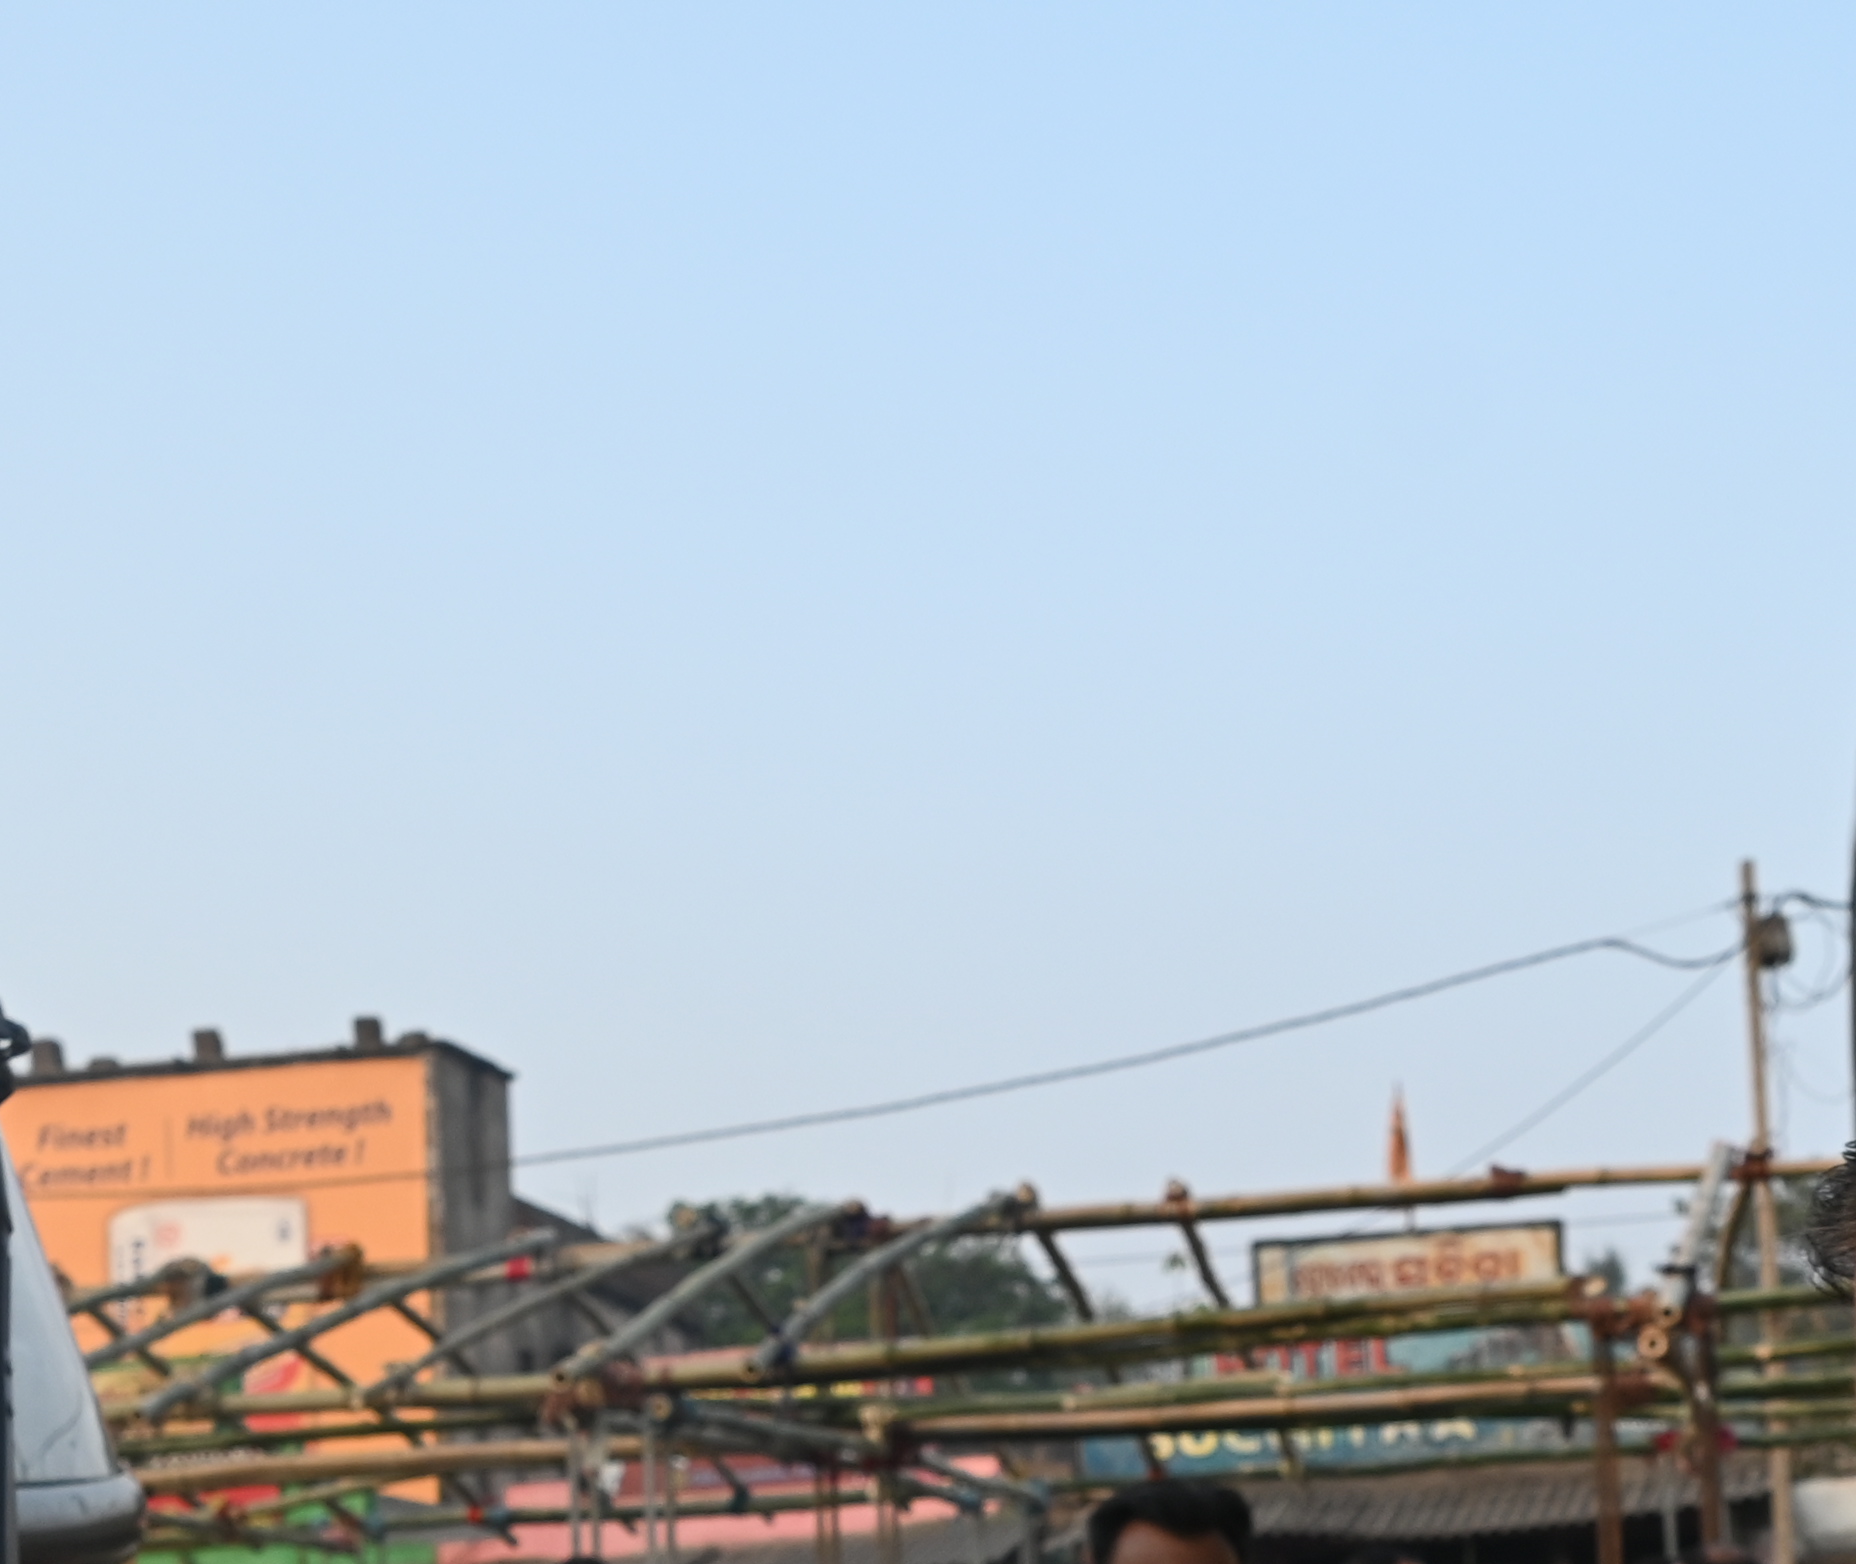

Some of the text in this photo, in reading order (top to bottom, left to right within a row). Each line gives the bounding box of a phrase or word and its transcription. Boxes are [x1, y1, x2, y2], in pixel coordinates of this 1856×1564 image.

[36, 1121, 128, 1152] Finest
[185, 1097, 393, 1142] High Strength
[215, 1143, 349, 1177] Concrete
